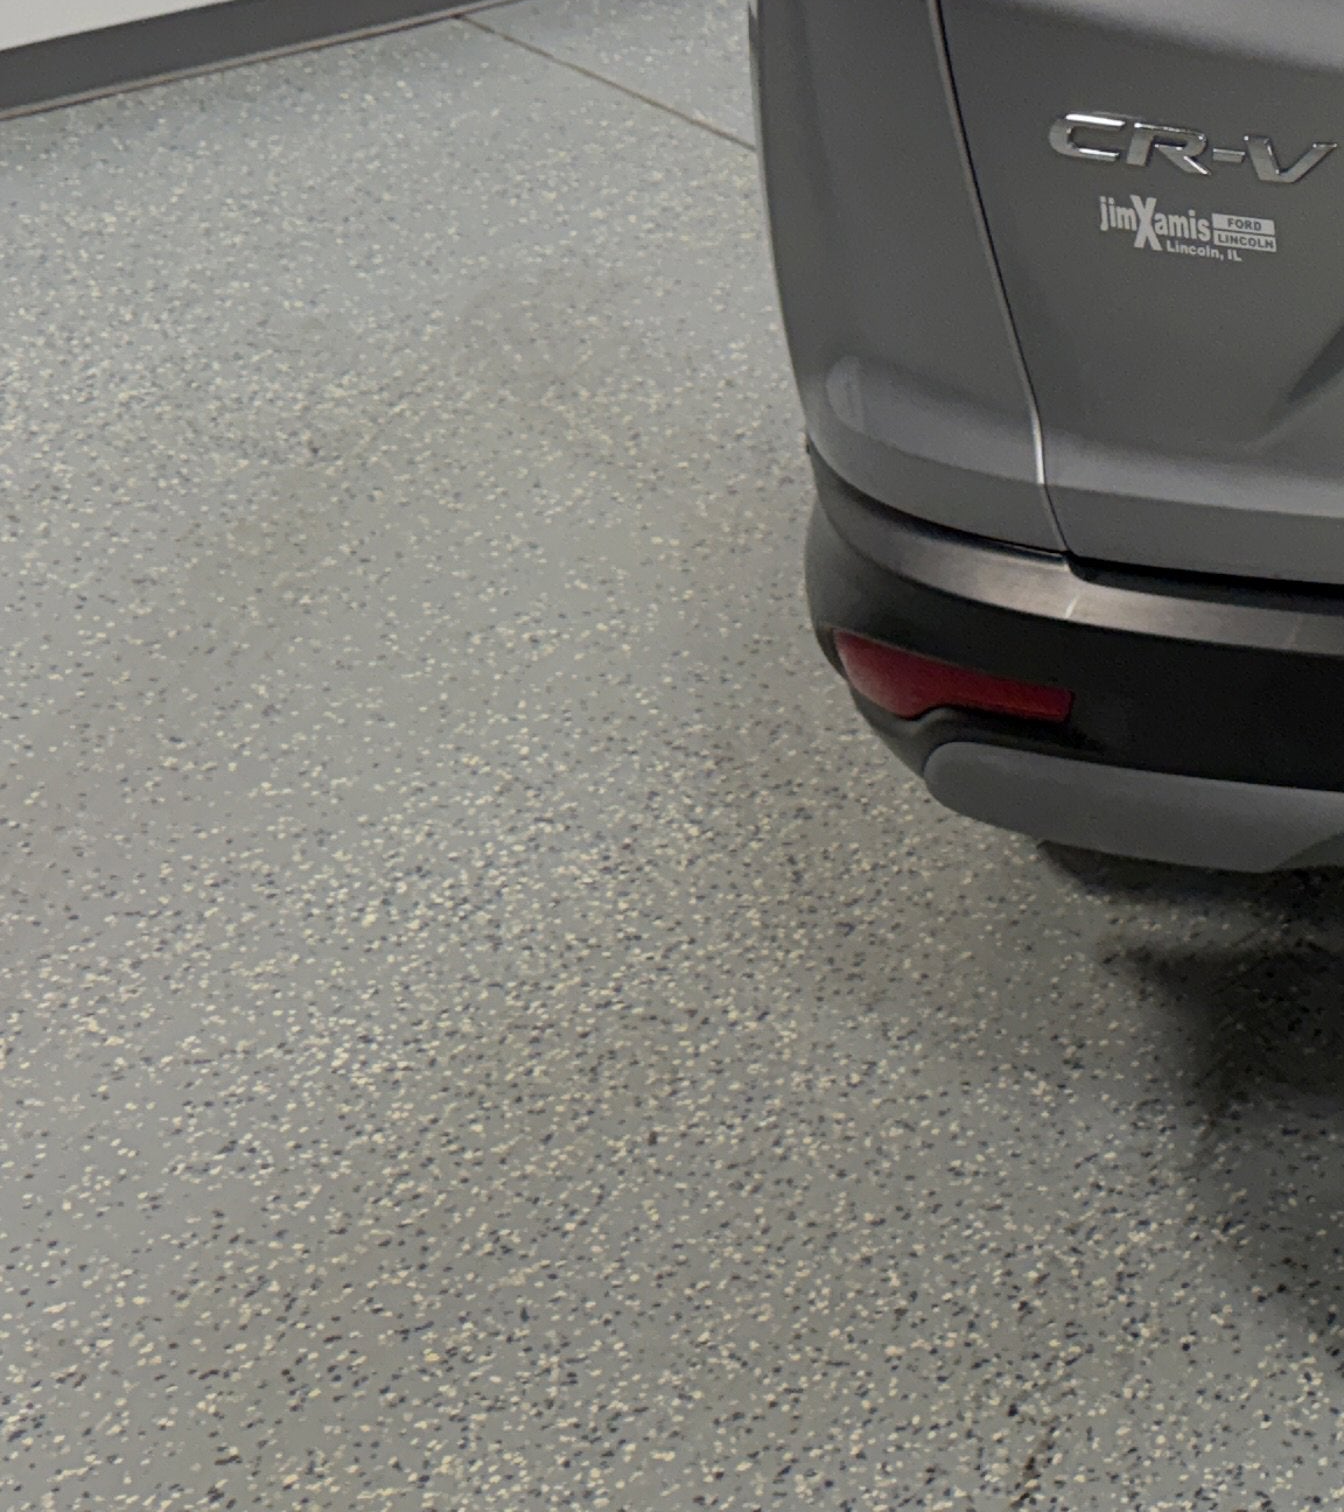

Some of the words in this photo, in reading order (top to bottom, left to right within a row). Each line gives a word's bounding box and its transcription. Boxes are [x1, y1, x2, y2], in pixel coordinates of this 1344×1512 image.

[1048, 112, 1339, 184] CR-V
[1226, 217, 1263, 232] FORD
[1166, 239, 1225, 261] Lincoln,
[1227, 249, 1243, 262] IL
[1217, 233, 1275, 251] LINCOLN
